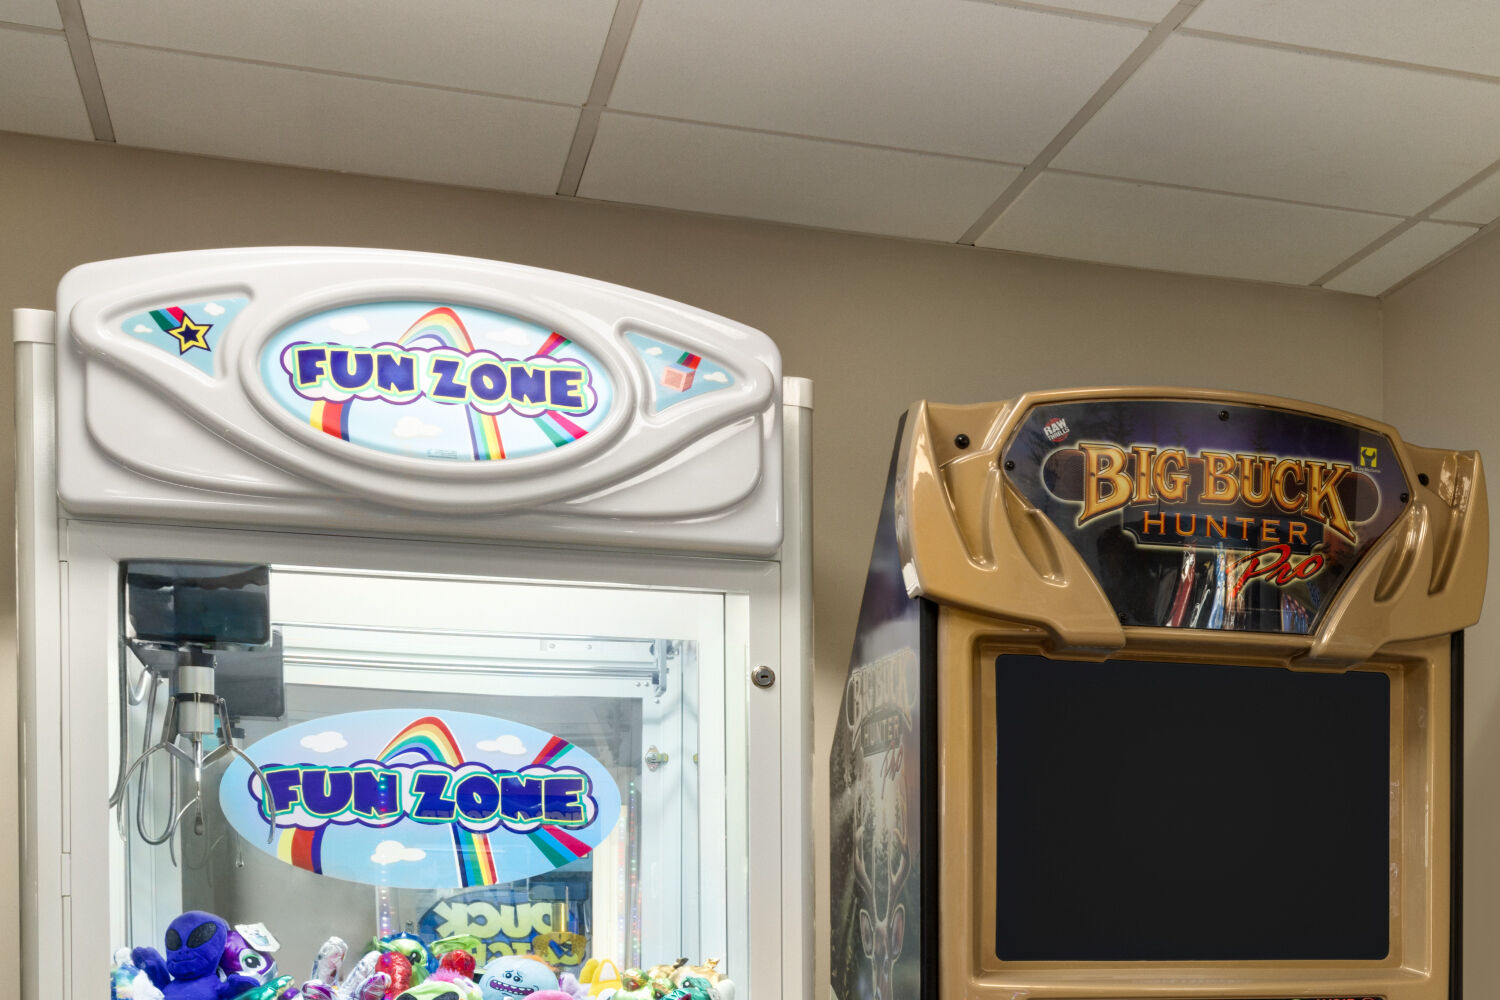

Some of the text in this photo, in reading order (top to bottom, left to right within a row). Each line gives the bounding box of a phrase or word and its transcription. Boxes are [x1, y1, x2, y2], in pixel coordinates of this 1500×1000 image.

[295, 347, 587, 410] FUN ZONE
[1043, 418, 1067, 437] RAW
[1077, 443, 1357, 544] BIG BUCK
[1143, 511, 1309, 544] HUNTER
[1226, 543, 1325, 598] Pro
[263, 767, 588, 823] FUN ZONE
